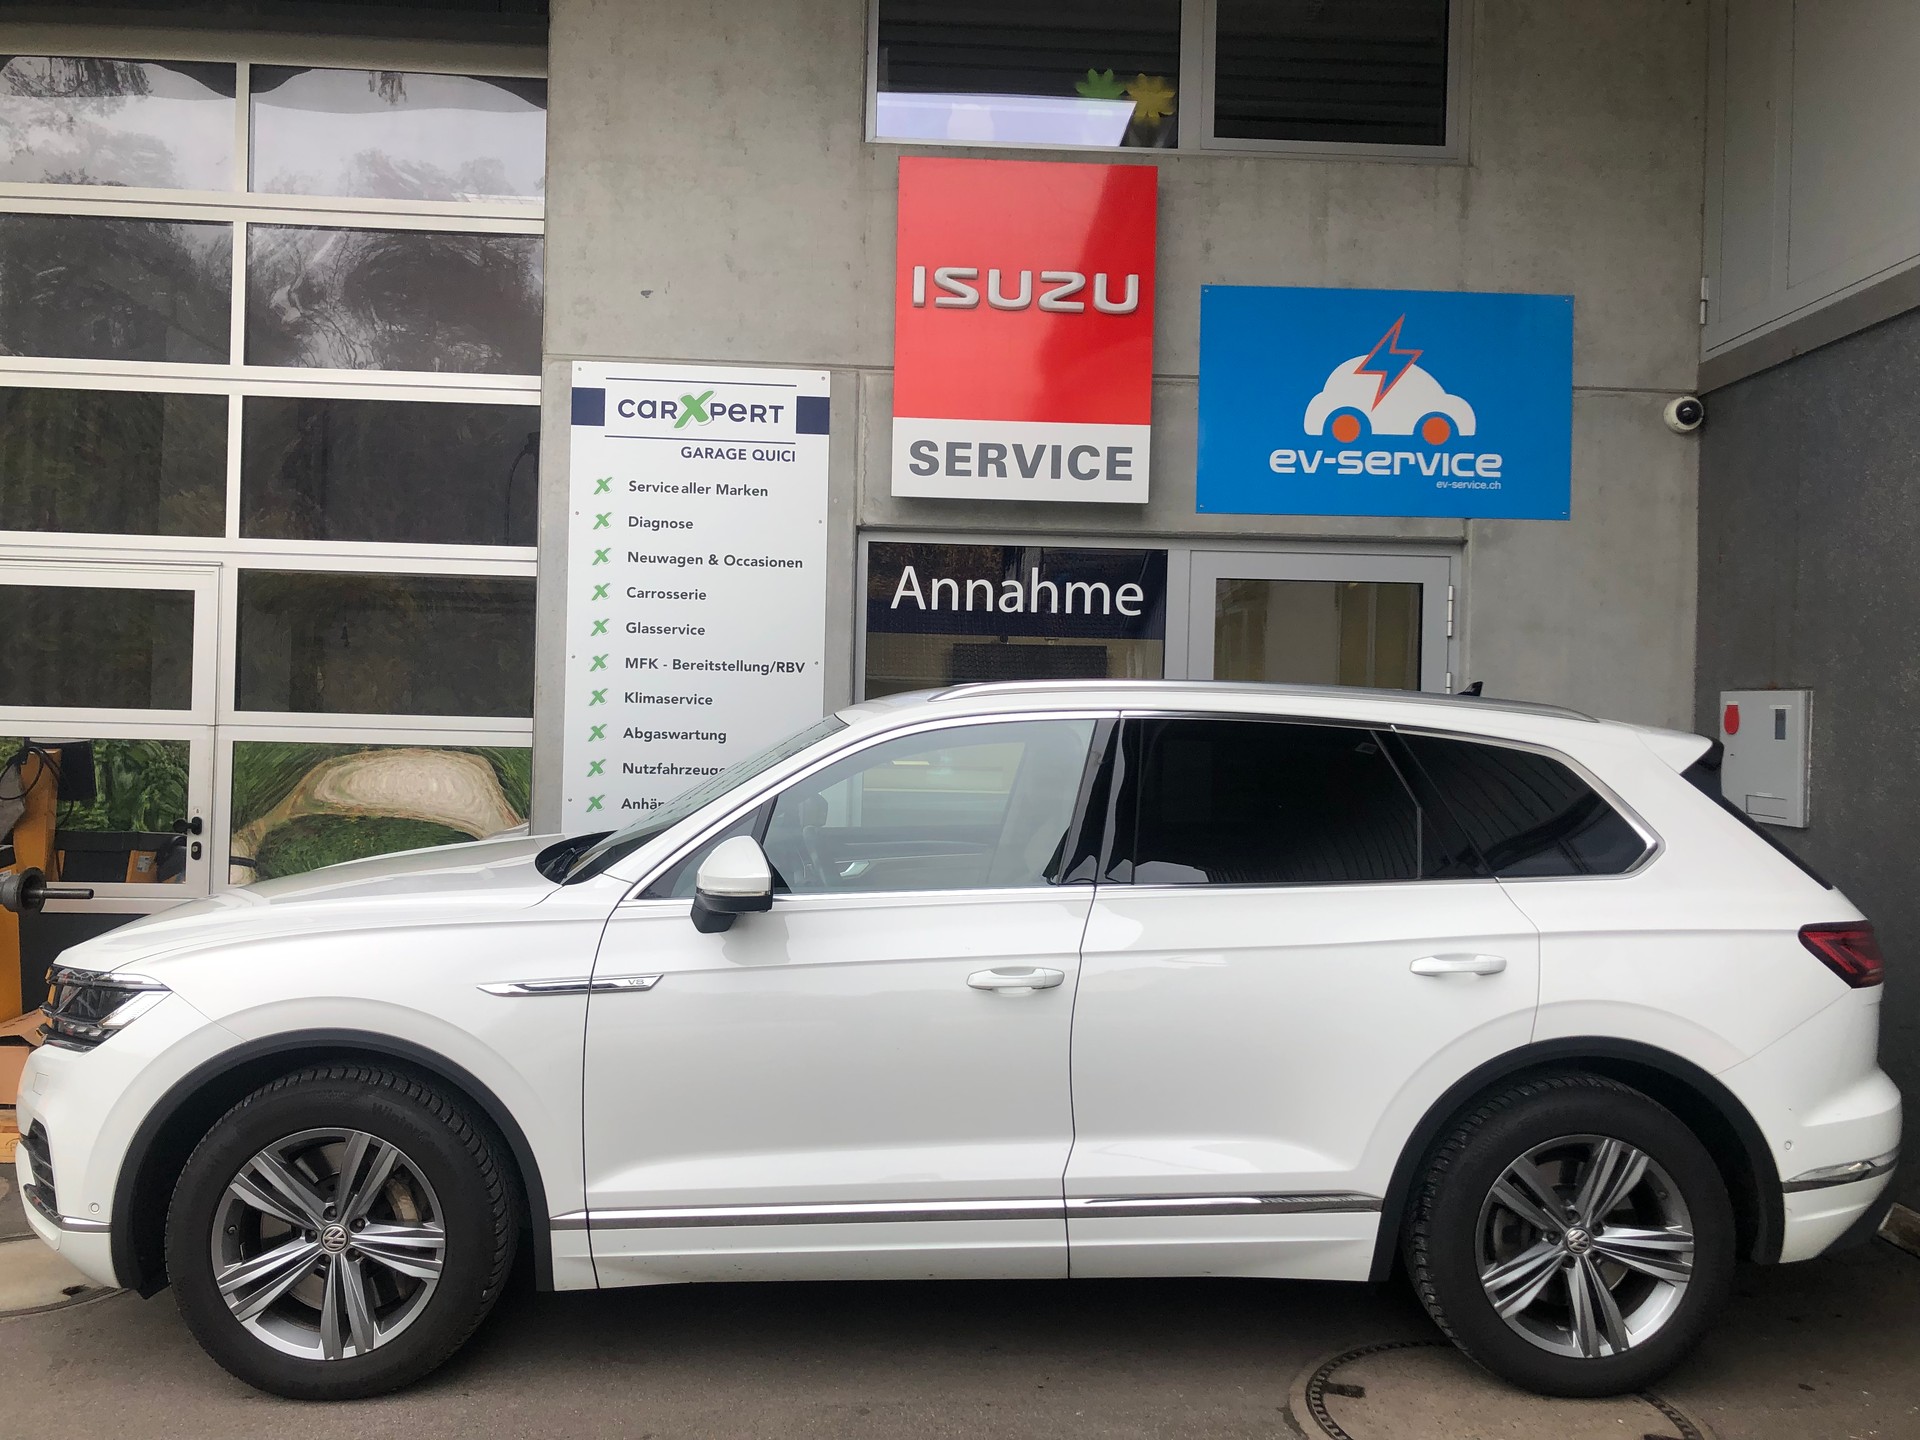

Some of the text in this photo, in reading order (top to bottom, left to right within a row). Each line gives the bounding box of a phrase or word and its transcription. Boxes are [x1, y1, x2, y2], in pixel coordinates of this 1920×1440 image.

[912, 265, 1139, 315] ISUZU
[680, 446, 796, 463] GARAGE QUICI
[908, 439, 1134, 482] SERVICE
[1268, 448, 1503, 478] ev-service
[715, 483, 769, 497] Marken
[1435, 479, 1502, 491] ev-service.ch
[628, 515, 694, 532] Diagnose
[627, 551, 803, 569] Neuwagen & Occasionen
[626, 586, 707, 601] Carrosserie
[890, 565, 1145, 617] Annahme
[625, 621, 706, 636] Glasservice
[625, 657, 660, 670] MFK
[672, 658, 806, 676] Bereitstellung/RBV
[624, 691, 714, 706] Klimaservice
[622, 727, 727, 744] Abgaswartung
